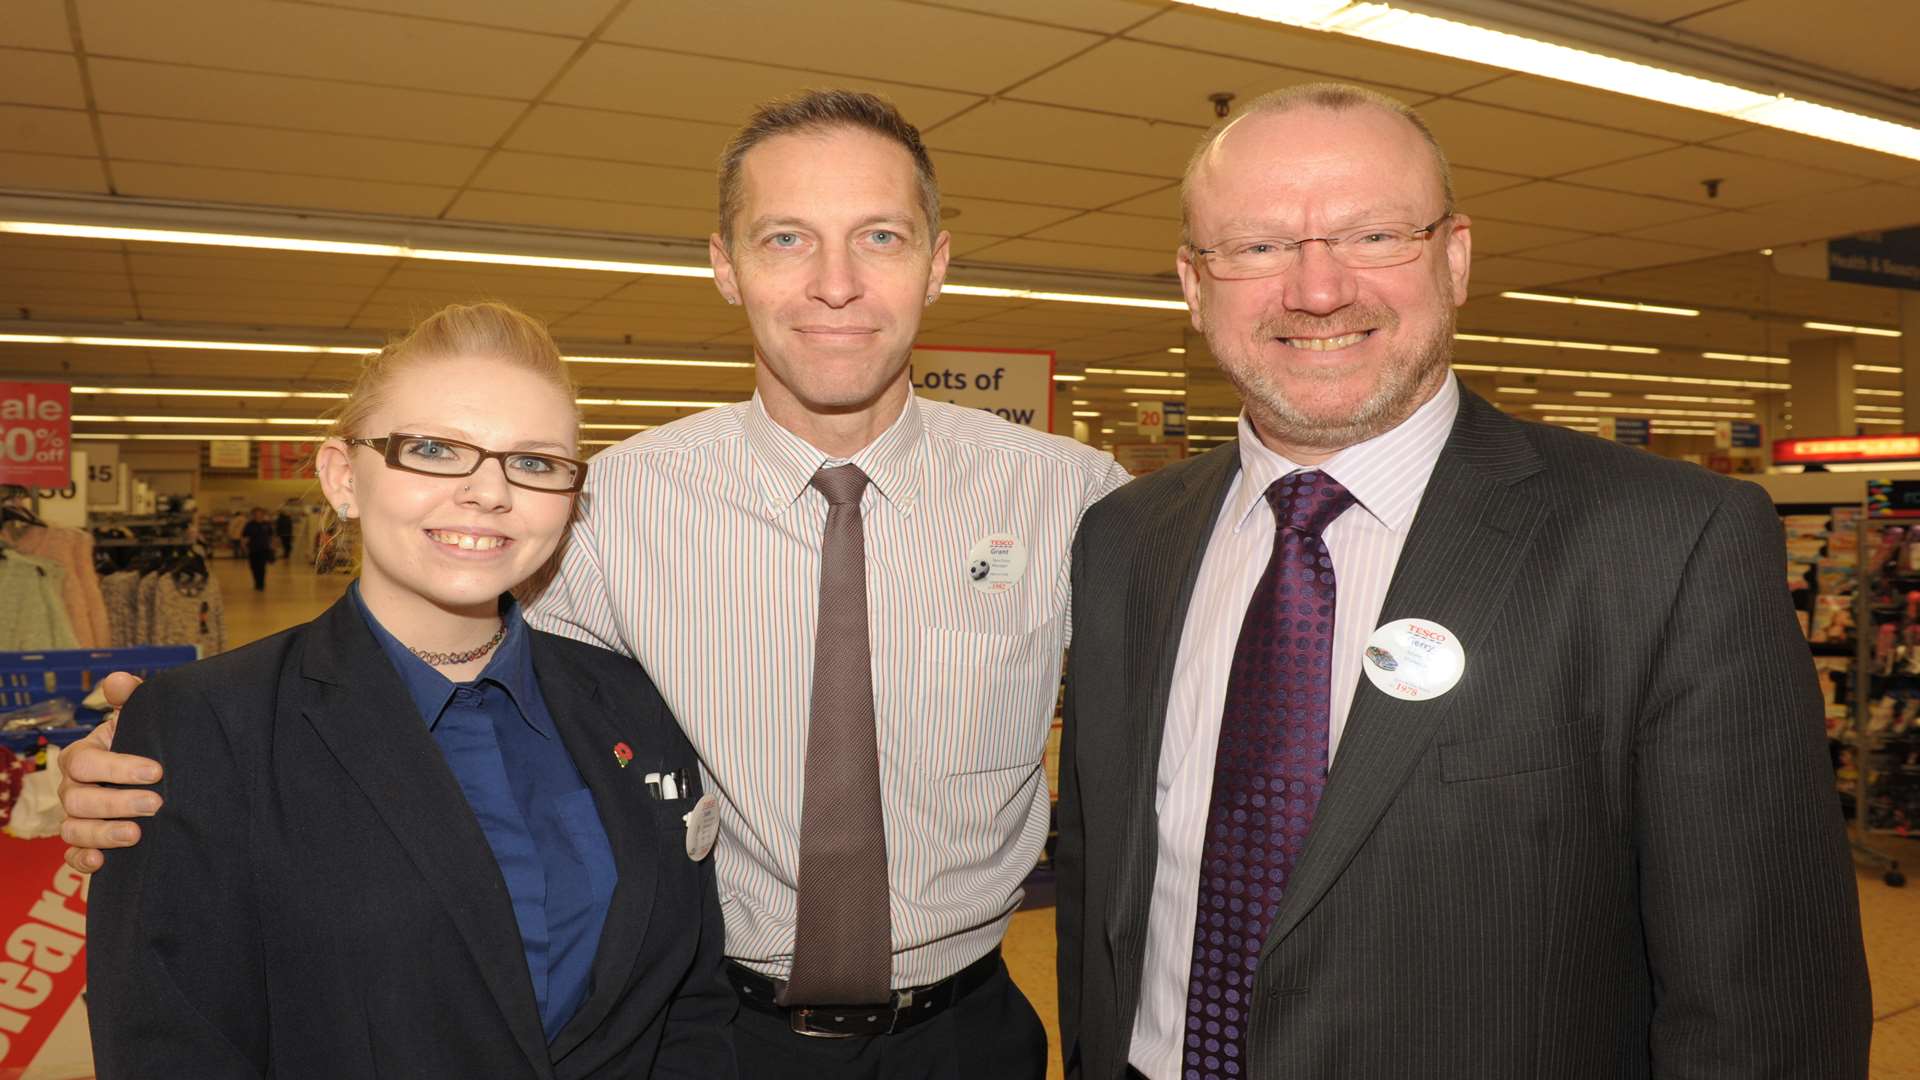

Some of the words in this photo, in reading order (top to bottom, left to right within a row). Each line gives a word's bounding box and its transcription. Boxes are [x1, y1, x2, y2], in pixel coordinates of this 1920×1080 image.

[910, 364, 967, 389] Lots
[975, 367, 1005, 391] of
[0, 393, 63, 420] ale
[1141, 410, 1160, 426] 20
[36, 450, 64, 461] off
[990, 548, 1009, 556] Grant
[1408, 623, 1446, 643] TESCO
[1396, 682, 1419, 697] 1978
